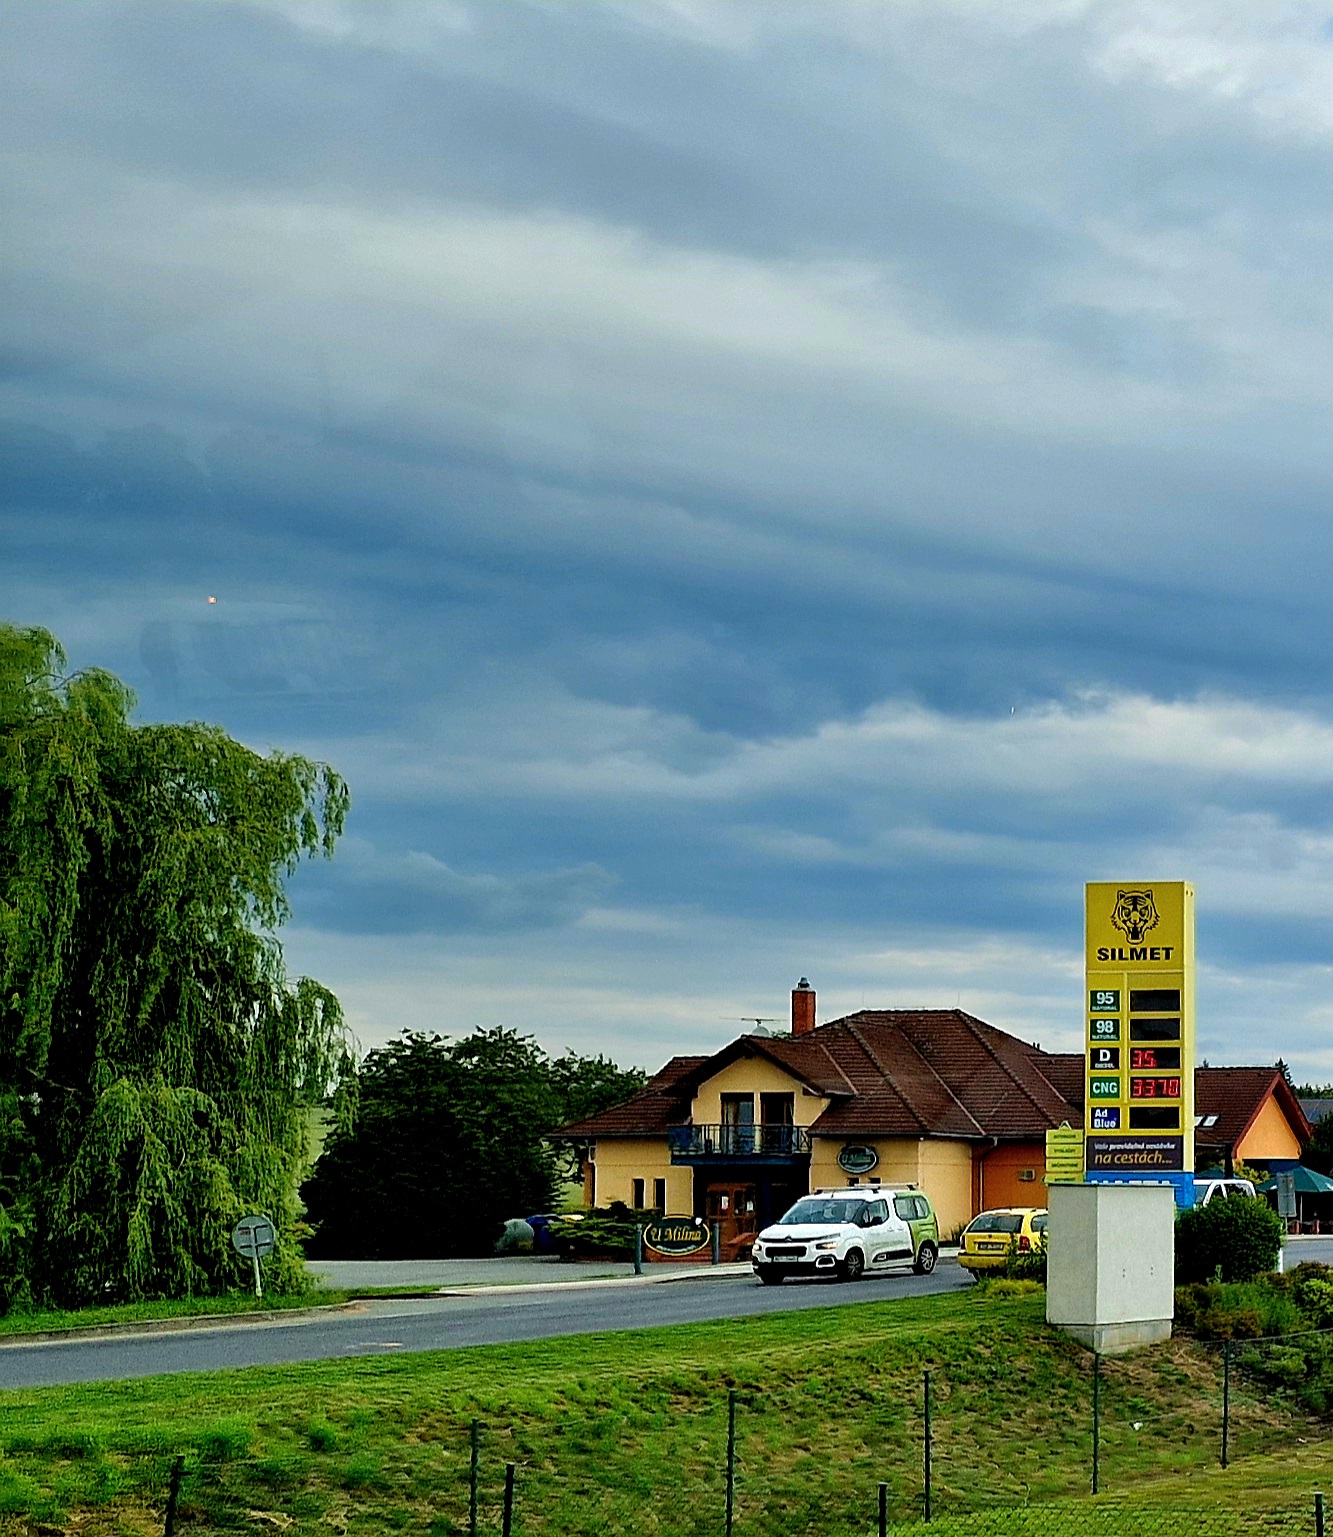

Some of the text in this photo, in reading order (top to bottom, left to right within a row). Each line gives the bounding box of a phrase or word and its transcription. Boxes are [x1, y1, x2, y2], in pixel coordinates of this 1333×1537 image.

[1096, 946, 1175, 962] SILMET
[1096, 991, 1115, 1005] 95
[1096, 1020, 1114, 1034] 98
[1099, 1048, 1111, 1062] D
[1092, 1081, 1118, 1095] CNG
[1094, 1108, 1109, 1118] Ad
[1093, 1118, 1117, 1129] Blue
[1094, 1153, 1112, 1164] na
